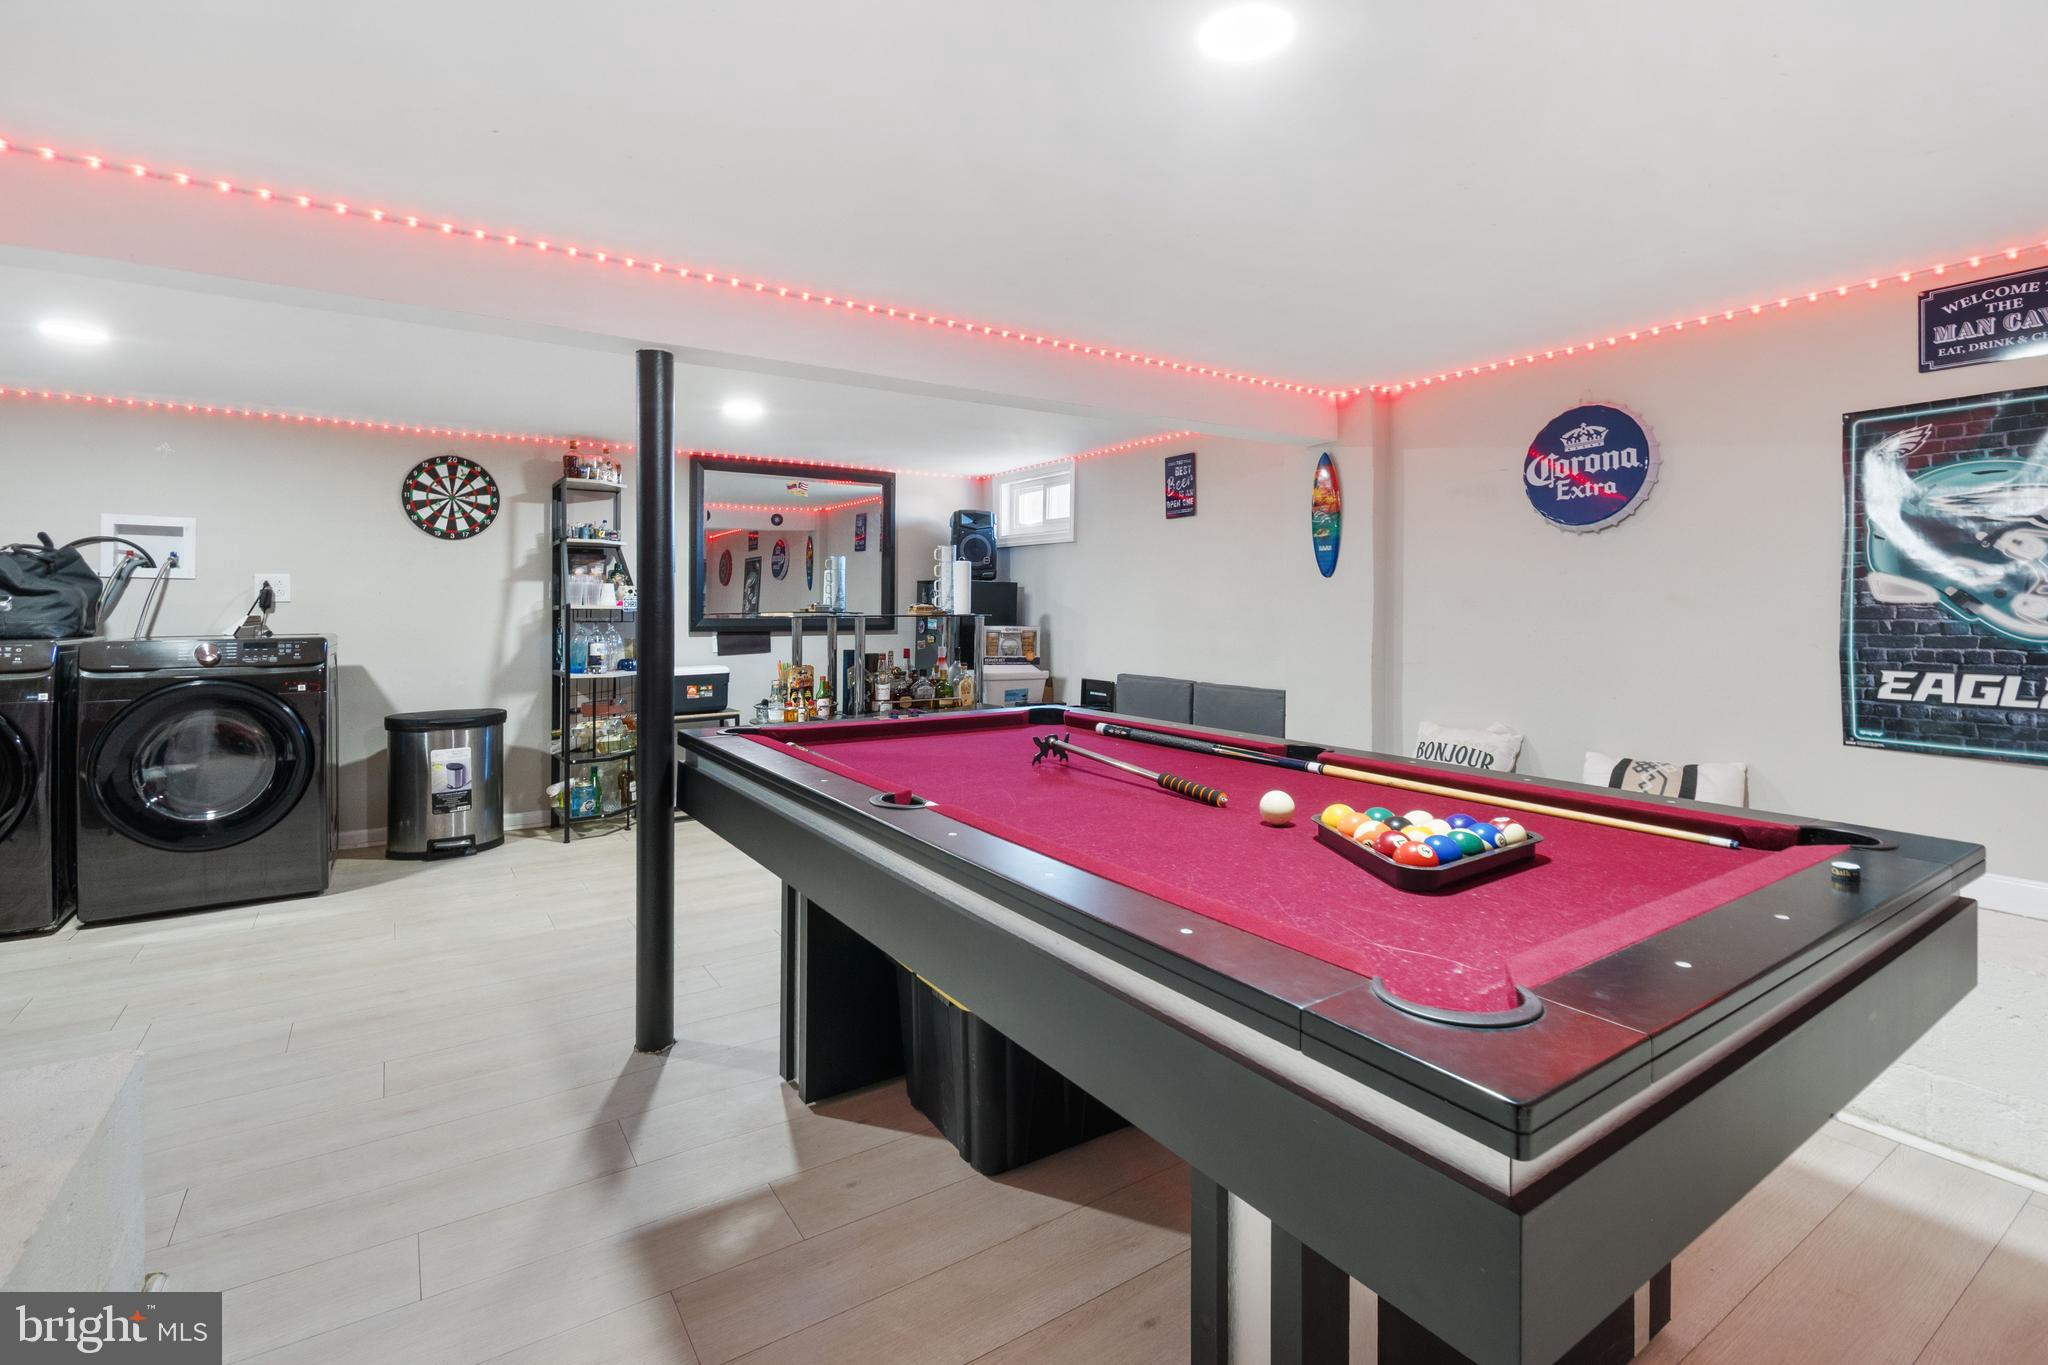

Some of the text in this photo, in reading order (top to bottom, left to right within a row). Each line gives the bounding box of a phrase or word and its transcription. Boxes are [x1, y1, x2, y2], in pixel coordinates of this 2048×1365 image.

[1941, 282, 2040, 314] WELCOME
[1985, 298, 2024, 313] THE
[1933, 316, 1996, 344] MAN
[1938, 346, 1966, 357] EAT,
[1969, 337, 2014, 352] DRINK
[2018, 335, 2028, 344] &
[1175, 465, 1192, 476] BEST
[1526, 447, 1640, 488] Corona
[1556, 479, 1617, 500] Extra
[1166, 500, 1181, 509] OPEN
[1877, 670, 2048, 709] EAGL
[1416, 741, 1495, 770] BONJOUR
